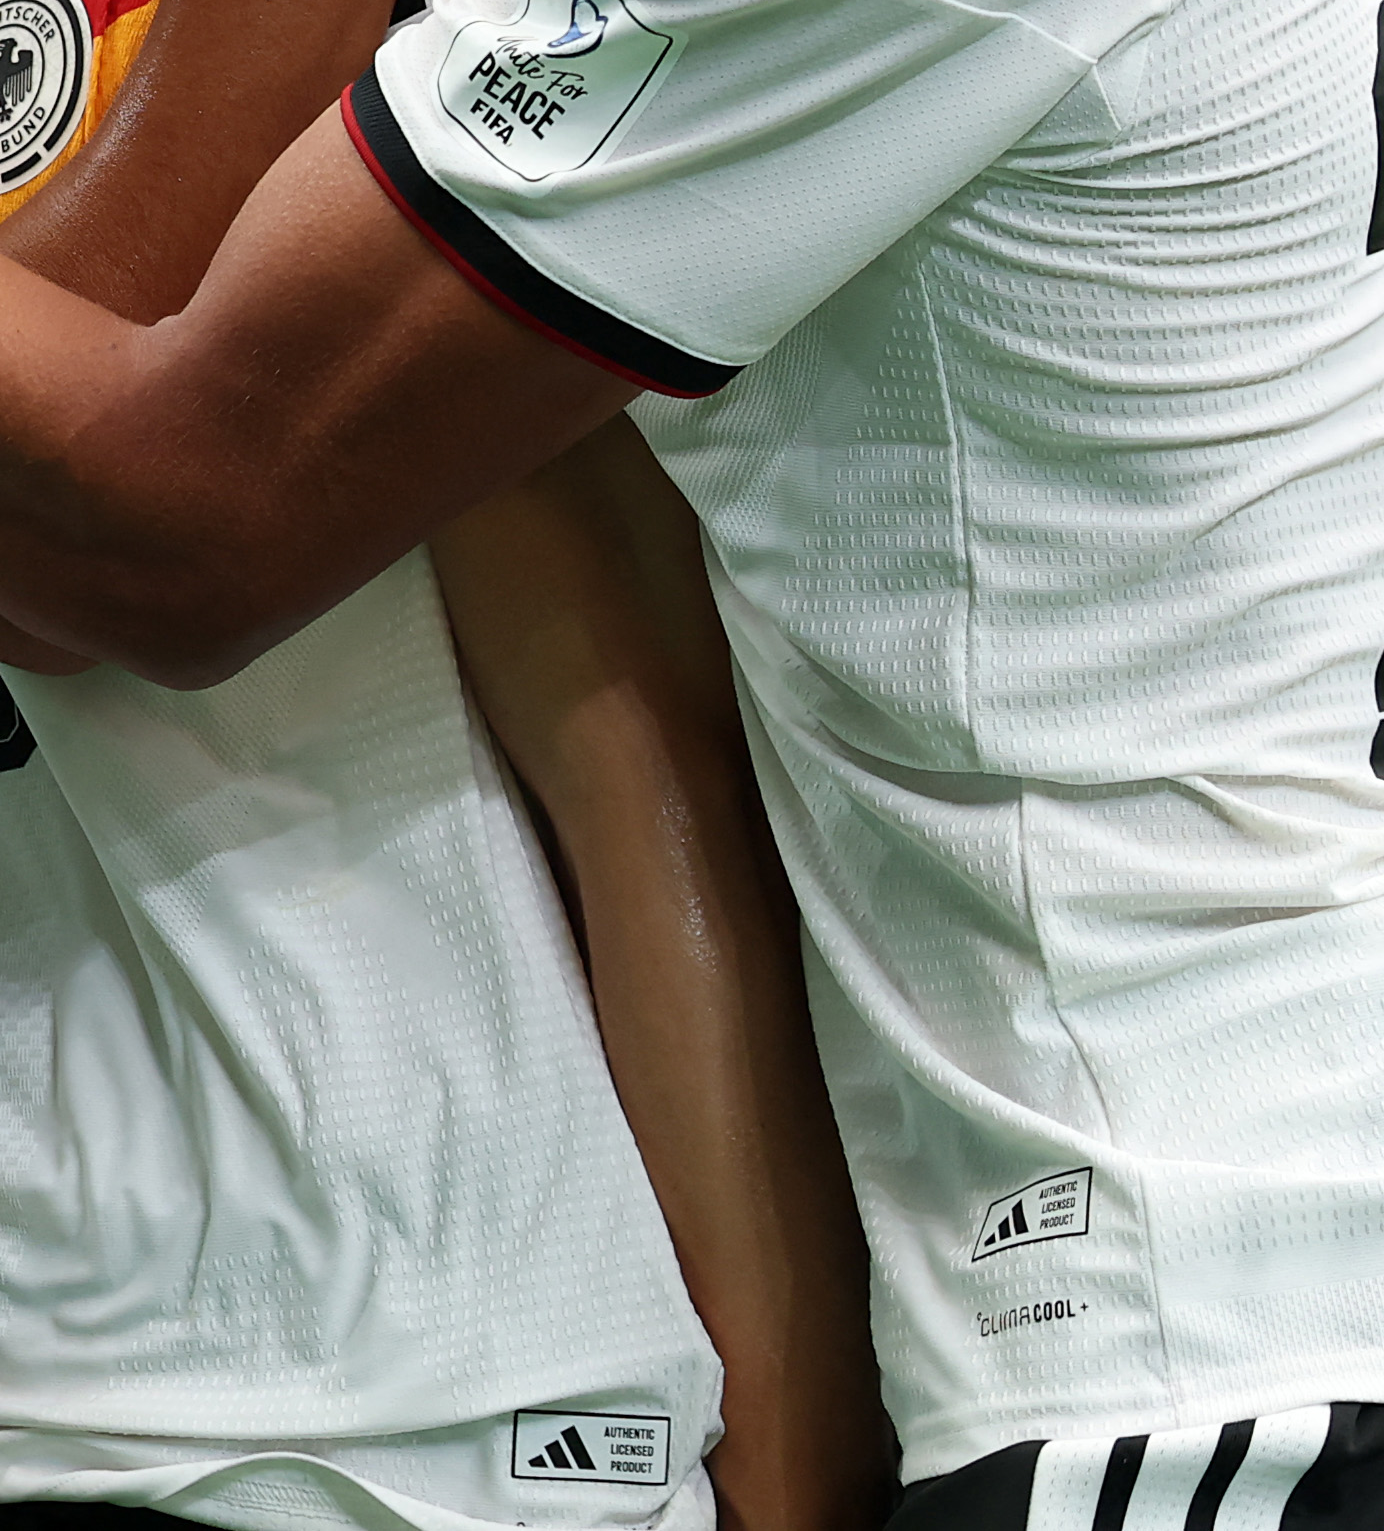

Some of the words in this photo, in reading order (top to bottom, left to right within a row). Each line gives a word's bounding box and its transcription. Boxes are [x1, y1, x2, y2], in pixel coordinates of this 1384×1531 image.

[547, 69, 589, 101] For
[468, 51, 566, 141] PEACE
[470, 98, 514, 145] FIFA
[1039, 1180, 1078, 1200] AUTHENTIC
[1041, 1197, 1076, 1214] LICENSED
[1039, 1213, 1075, 1230] PRODUCT
[604, 1426, 655, 1440] AUTHENTIC
[610, 1444, 654, 1457] LICENSED
[610, 1461, 653, 1474] PRODUCT
